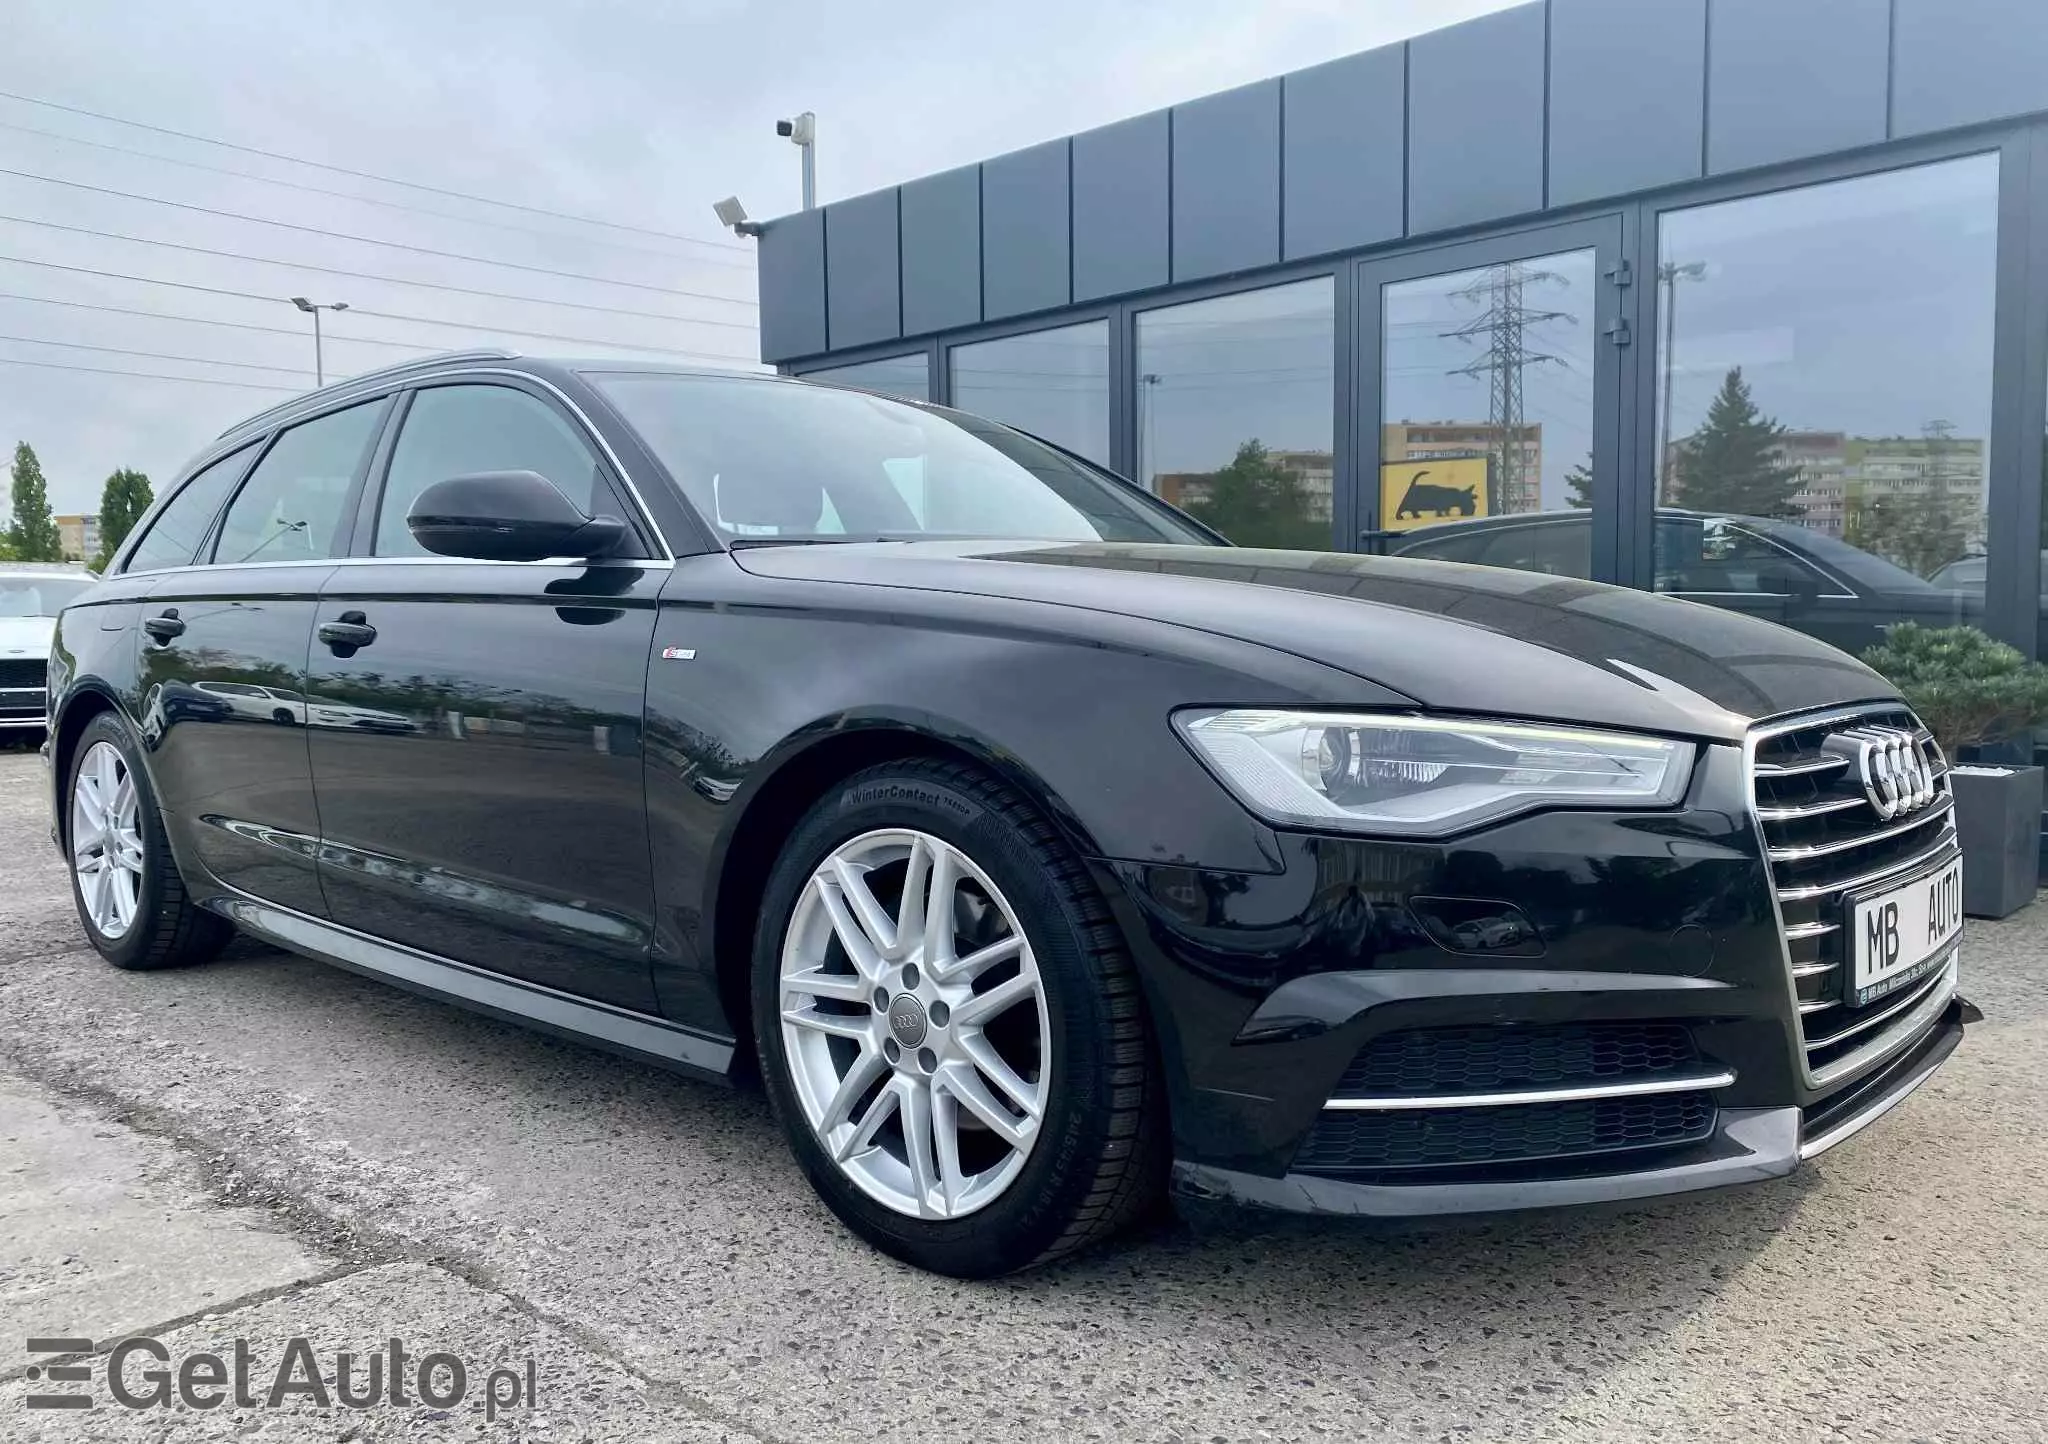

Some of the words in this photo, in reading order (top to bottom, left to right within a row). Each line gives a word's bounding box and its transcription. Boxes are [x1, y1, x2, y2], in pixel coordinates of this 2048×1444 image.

[852, 785, 940, 806] WinterContact
[1867, 901, 1899, 975] MB
[1928, 867, 1959, 945] AUTO
